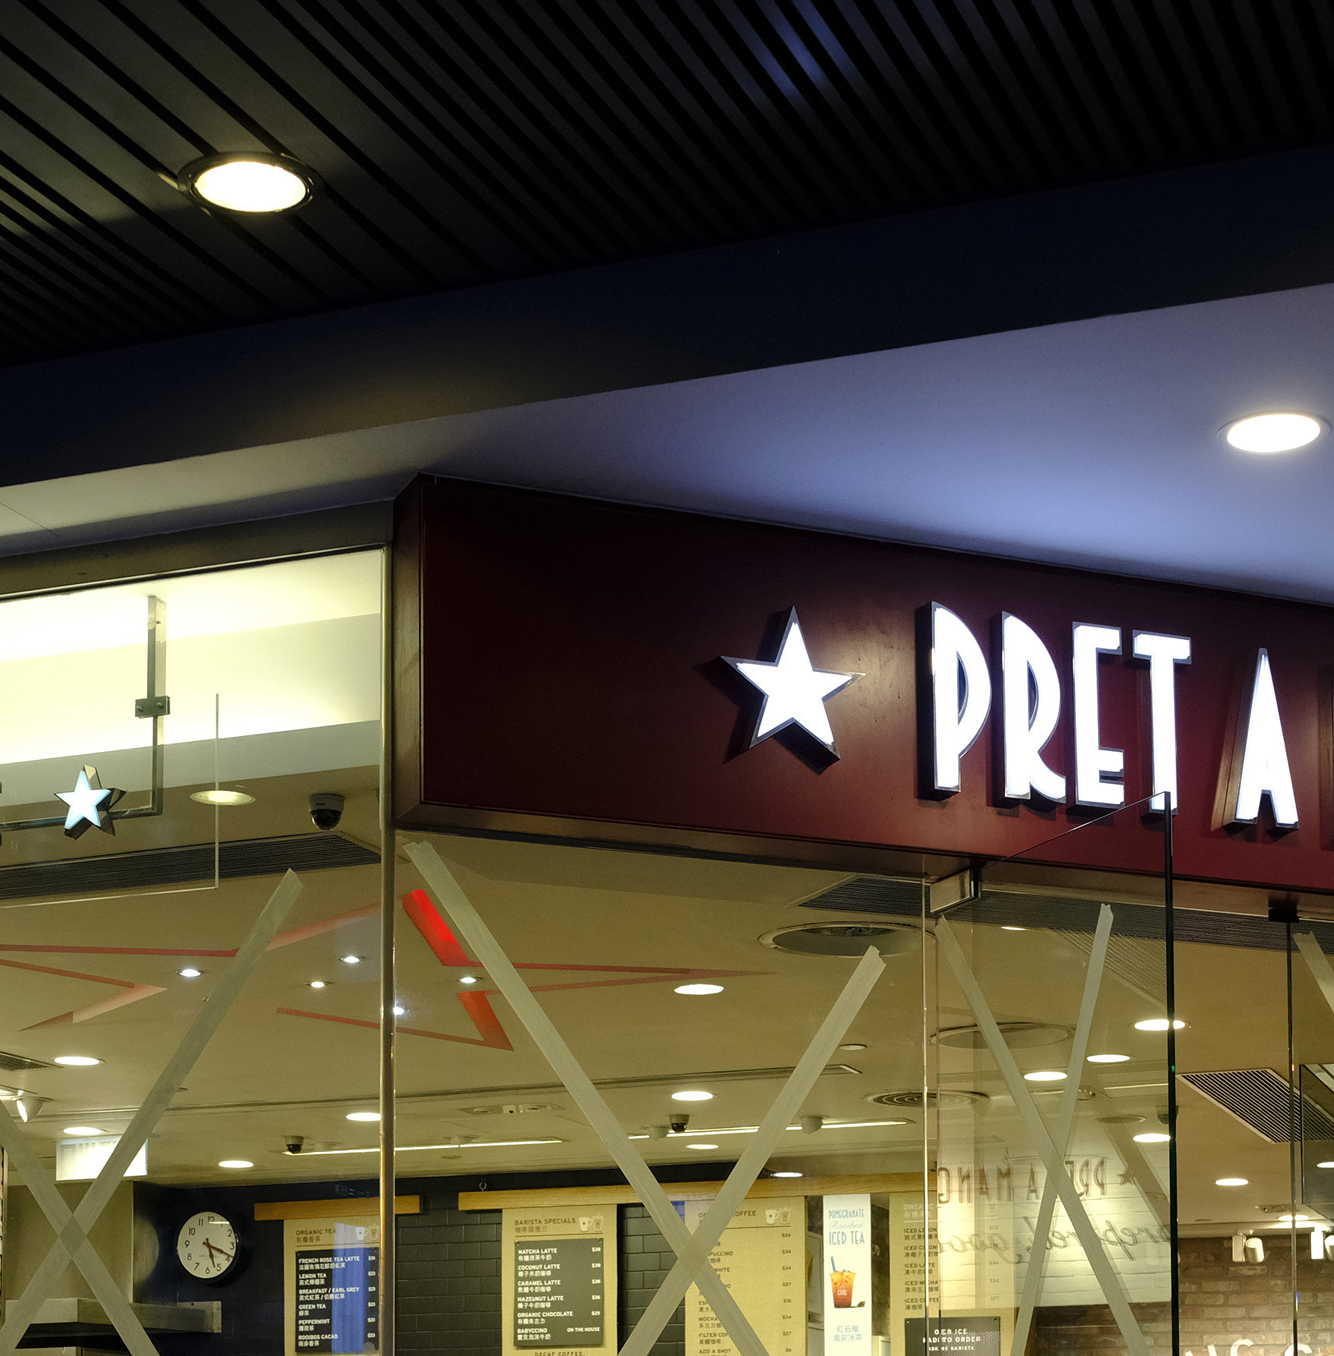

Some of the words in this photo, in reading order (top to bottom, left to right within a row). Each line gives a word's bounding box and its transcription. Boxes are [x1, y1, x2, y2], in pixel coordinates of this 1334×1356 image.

[929, 602, 1193, 815] PRET
[1230, 648, 1299, 832] A
[828, 1208, 864, 1219] POMEGRANATE
[198, 1219, 204, 1227] 11
[544, 1217, 576, 1225] SPECIALS
[188, 1227, 196, 1236] 10
[227, 1229, 232, 1238] 2
[829, 1231, 847, 1245] ICED
[851, 1230, 865, 1245] TEA
[184, 1240, 190, 1248] 9
[229, 1242, 235, 1250] 3
[187, 1253, 192, 1261] 8
[194, 1262, 200, 1271] 7
[216, 1263, 222, 1271] 5
